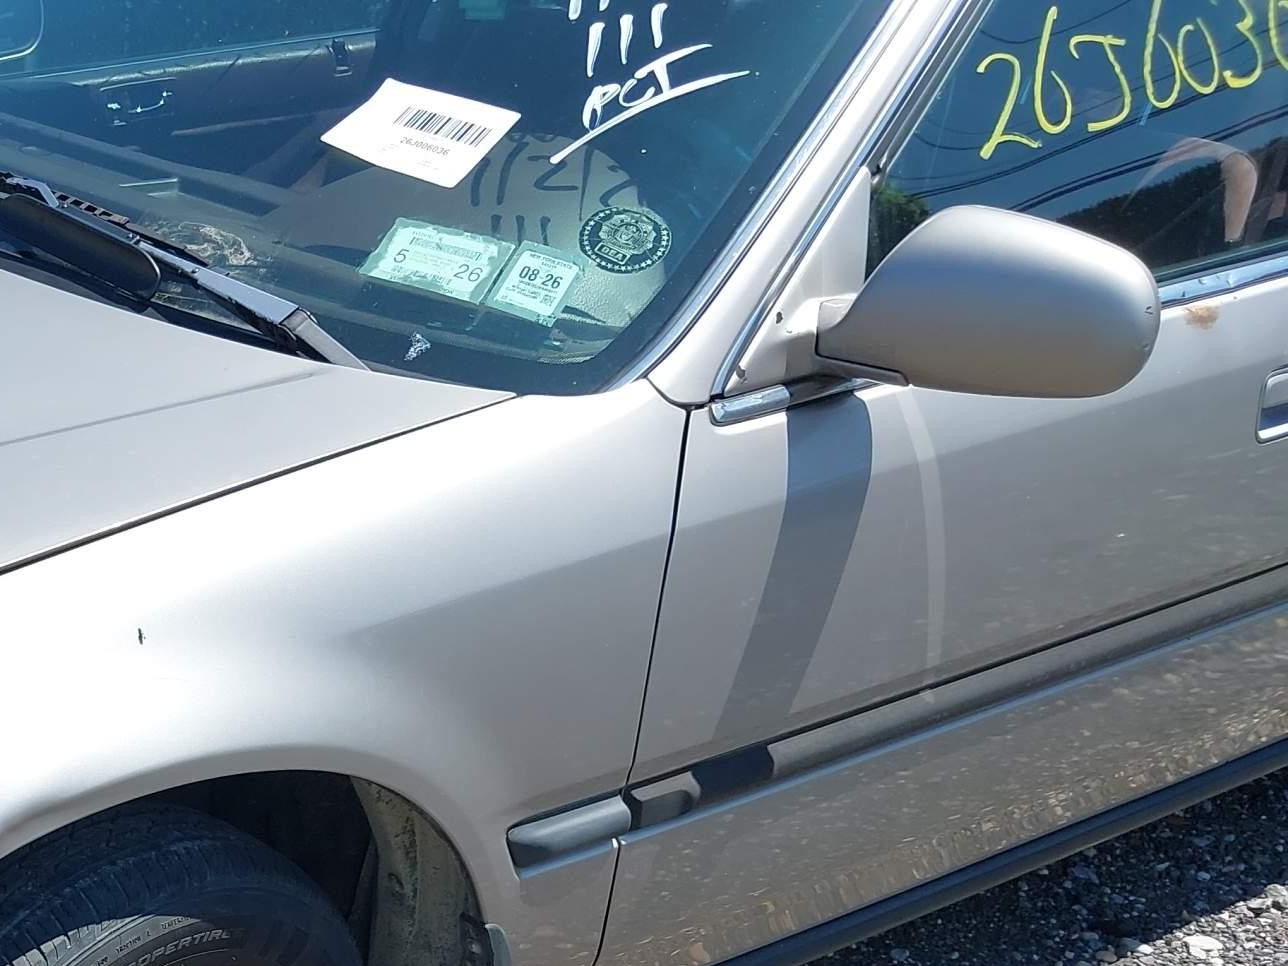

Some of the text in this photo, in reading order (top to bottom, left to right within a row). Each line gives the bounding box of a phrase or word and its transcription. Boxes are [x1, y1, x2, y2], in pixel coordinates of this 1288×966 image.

[399, 136, 451, 157] 26J006036
[393, 248, 410, 263] 5
[601, 246, 624, 261] DEA
[453, 263, 483, 282] 26
